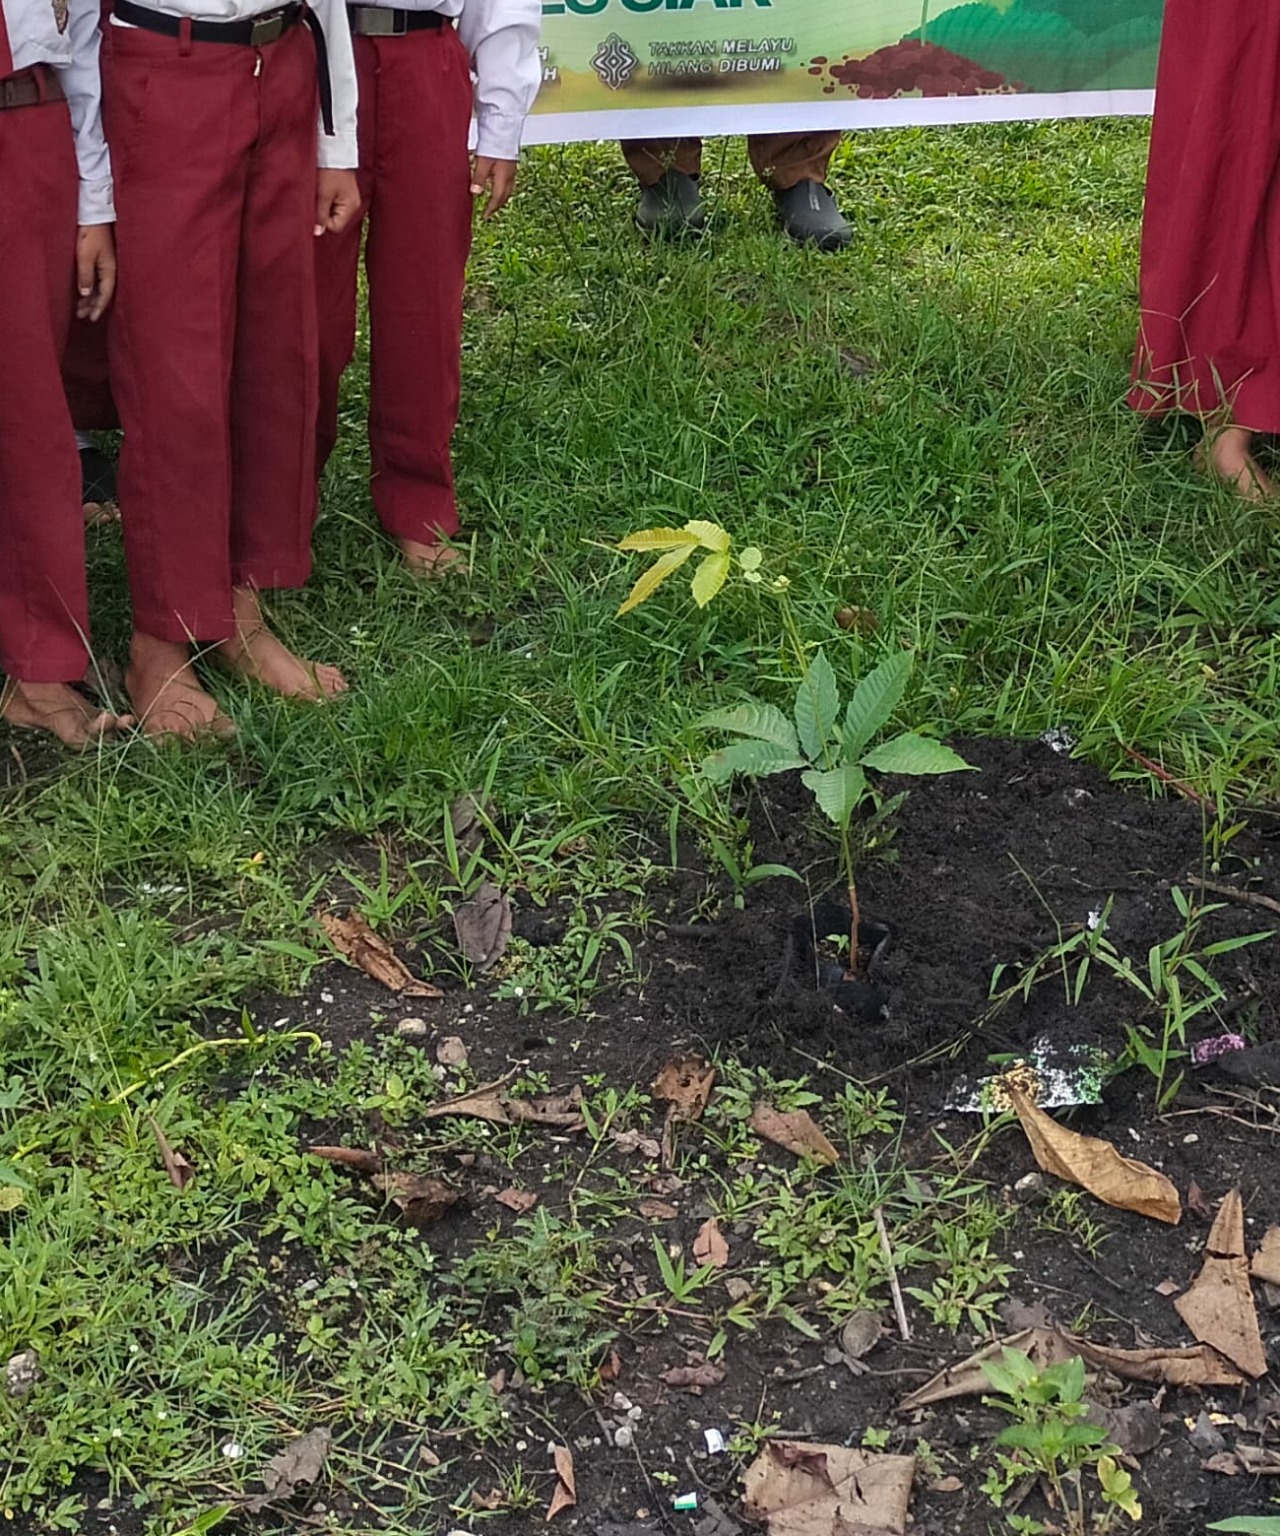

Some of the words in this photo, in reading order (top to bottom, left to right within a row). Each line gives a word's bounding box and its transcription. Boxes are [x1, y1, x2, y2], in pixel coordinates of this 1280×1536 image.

[649, 40, 717, 57] TAKKAN
[721, 37, 794, 54] MELAYU
[648, 60, 713, 76] HILANG
[718, 58, 781, 73] DIBUMI
